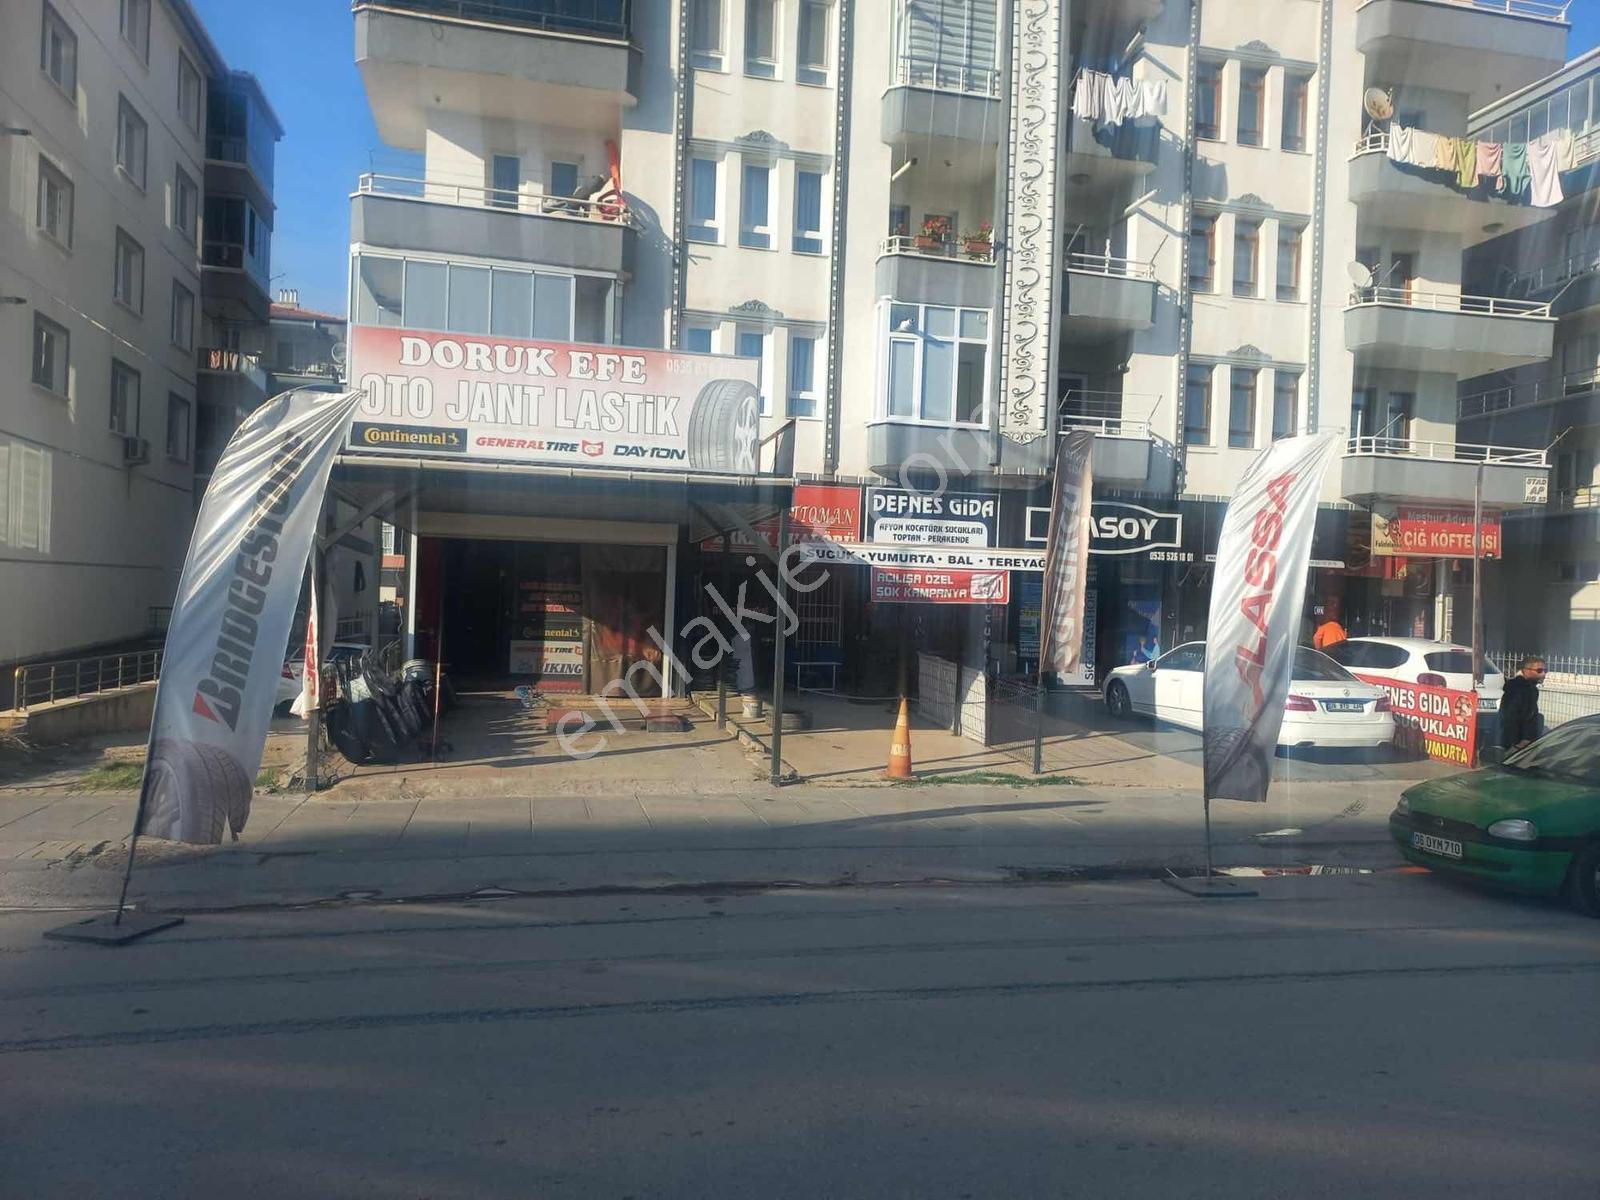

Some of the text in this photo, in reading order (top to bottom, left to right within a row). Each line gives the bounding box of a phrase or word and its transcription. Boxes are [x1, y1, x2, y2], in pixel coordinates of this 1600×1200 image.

[399, 336, 647, 384] DORUK EFE
[360, 373, 436, 418] OTO
[446, 379, 545, 427] JANT
[364, 427, 447, 445] Continental
[613, 445, 686, 460] DAYTON
[873, 494, 944, 515] DEFNES
[880, 523, 903, 531] AFYON
[893, 533, 970, 544] TOPTAN PERAKENDE
[1403, 528, 1427, 550] ÇİĞ
[807, 549, 856, 561] SUCUK
[868, 550, 936, 564] YUMURTA
[948, 555, 974, 565] BAL
[1236, 472, 1299, 668] LASSA
[903, 587, 968, 599] KAMPANYA
[1419, 692, 1451, 717] GIDA
